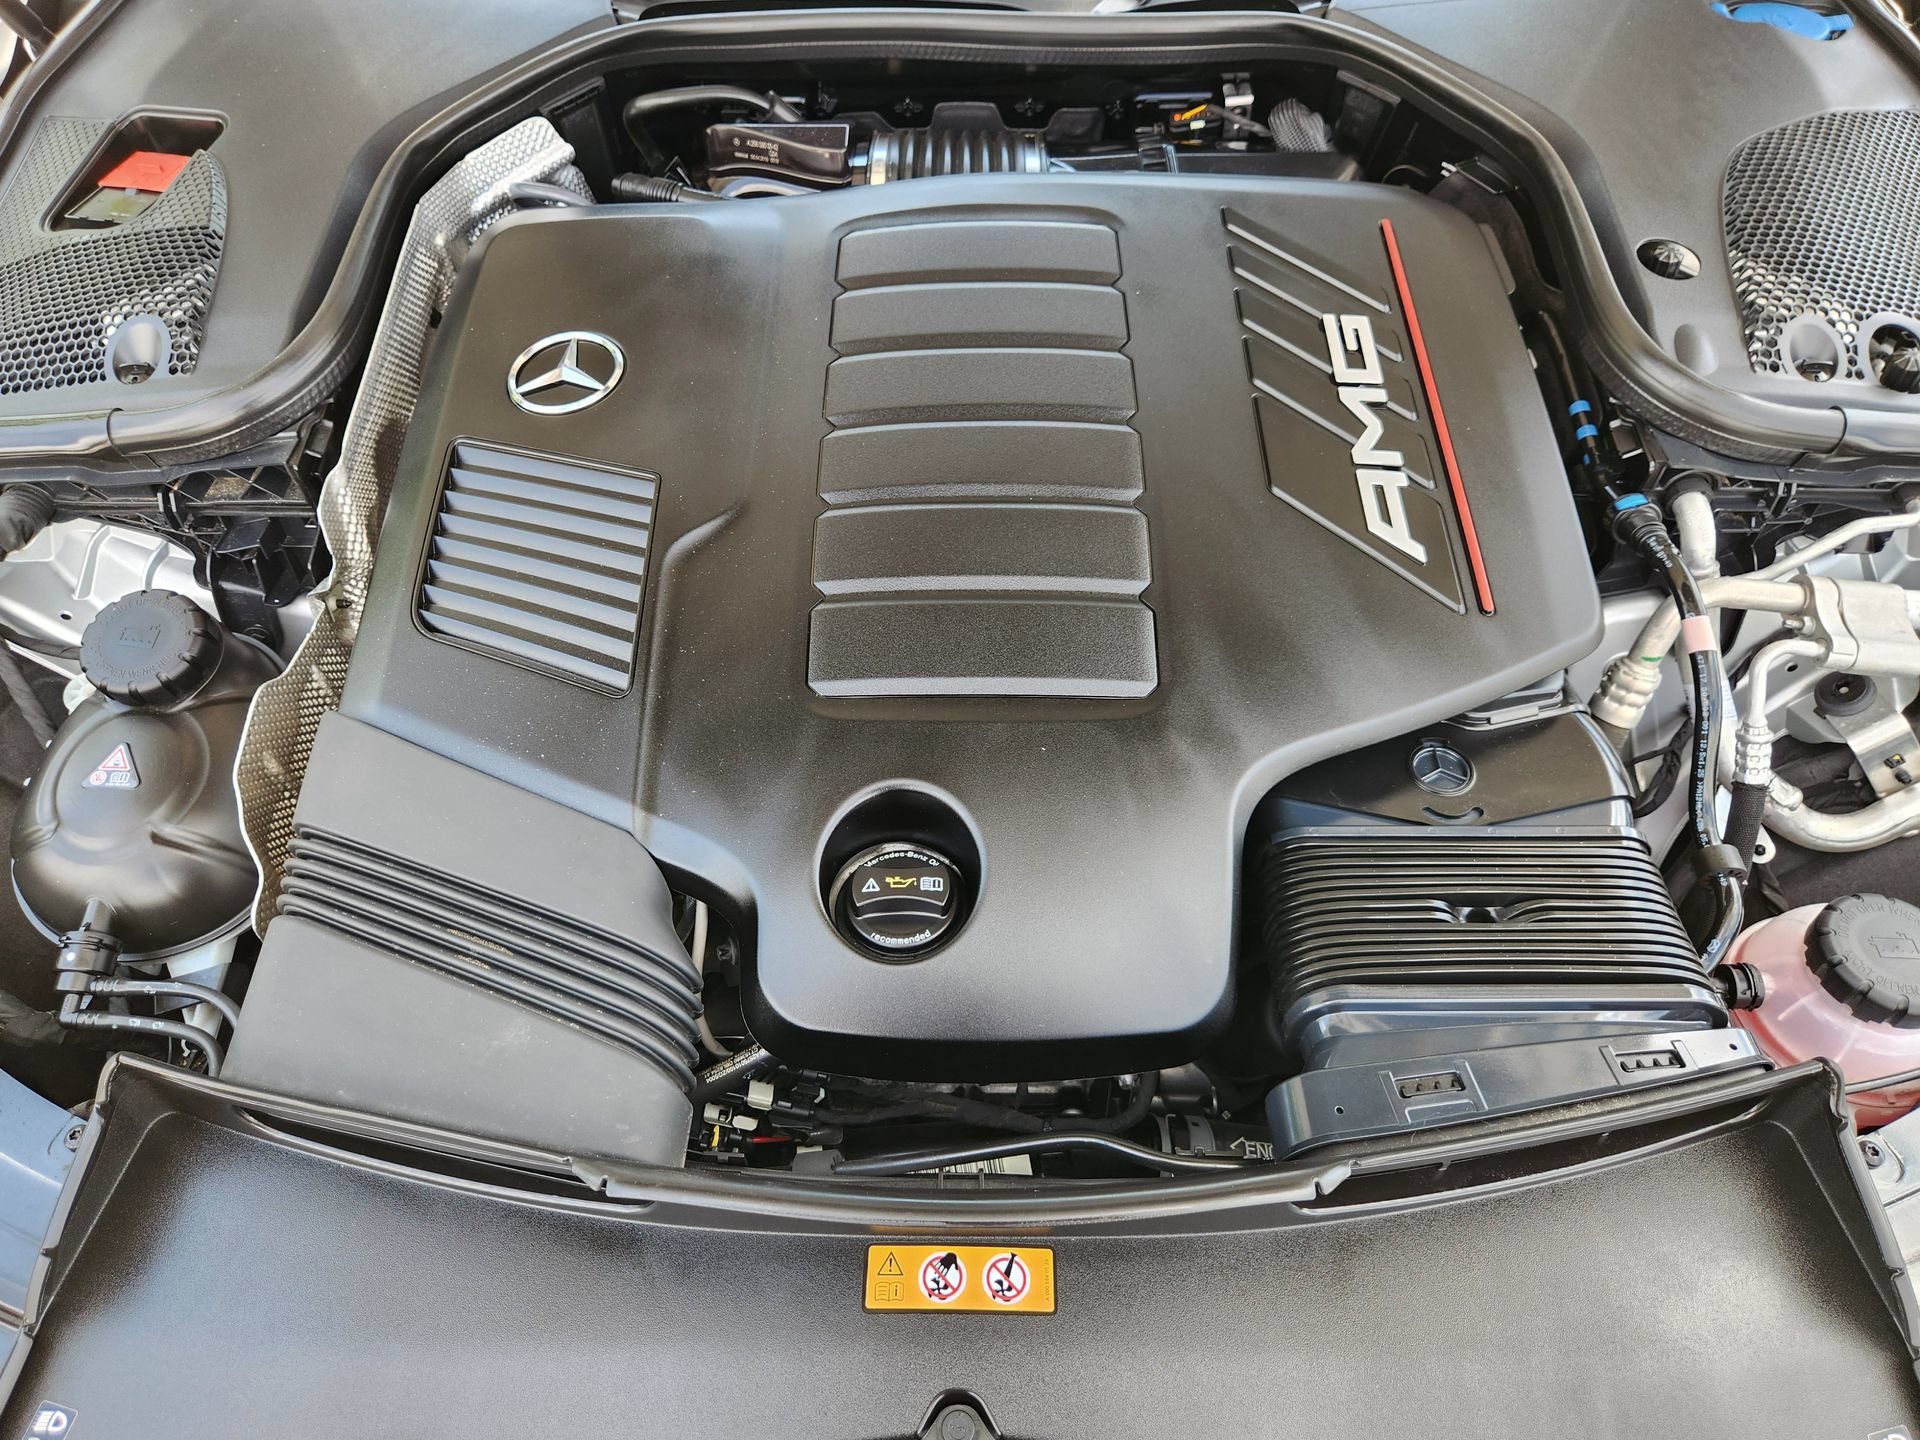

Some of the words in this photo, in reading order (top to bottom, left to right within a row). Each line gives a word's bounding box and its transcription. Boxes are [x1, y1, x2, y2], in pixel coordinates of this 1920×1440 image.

[1322, 313, 1428, 565] AMG
[863, 851, 928, 867] Mercedes-Benz
[870, 929, 932, 945] recommended
